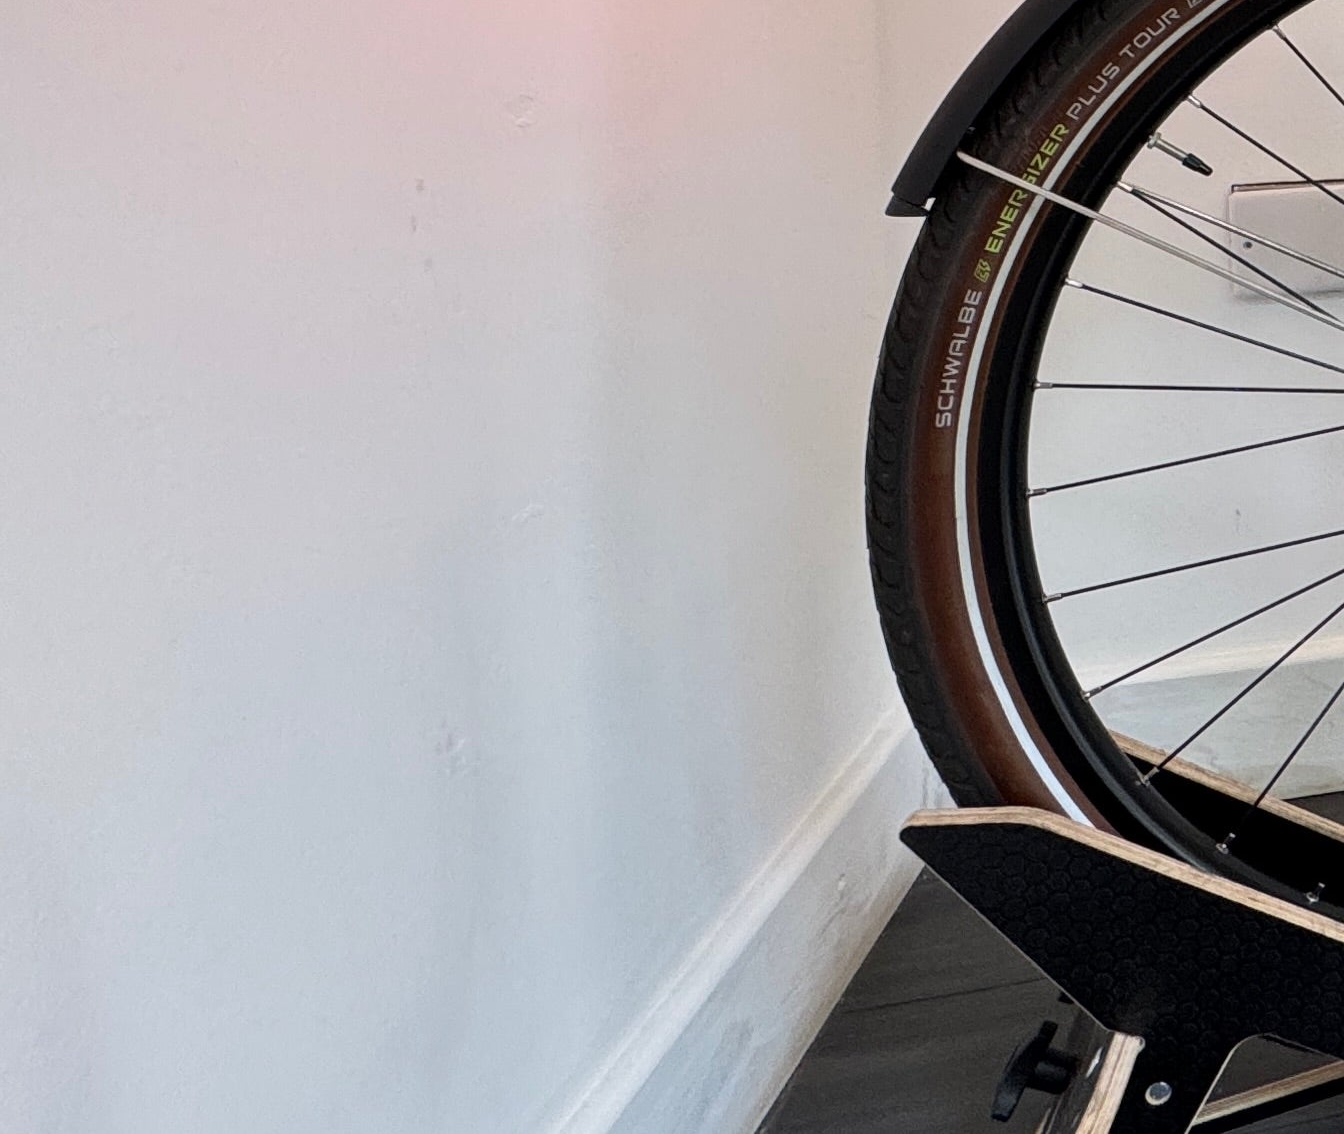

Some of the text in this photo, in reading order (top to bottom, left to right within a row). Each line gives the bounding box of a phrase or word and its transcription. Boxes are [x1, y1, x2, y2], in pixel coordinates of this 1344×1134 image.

[935, 289, 982, 429] SCHWALBE
[1066, 62, 1121, 122] PLUS
[1119, 6, 1181, 59] TOUR
